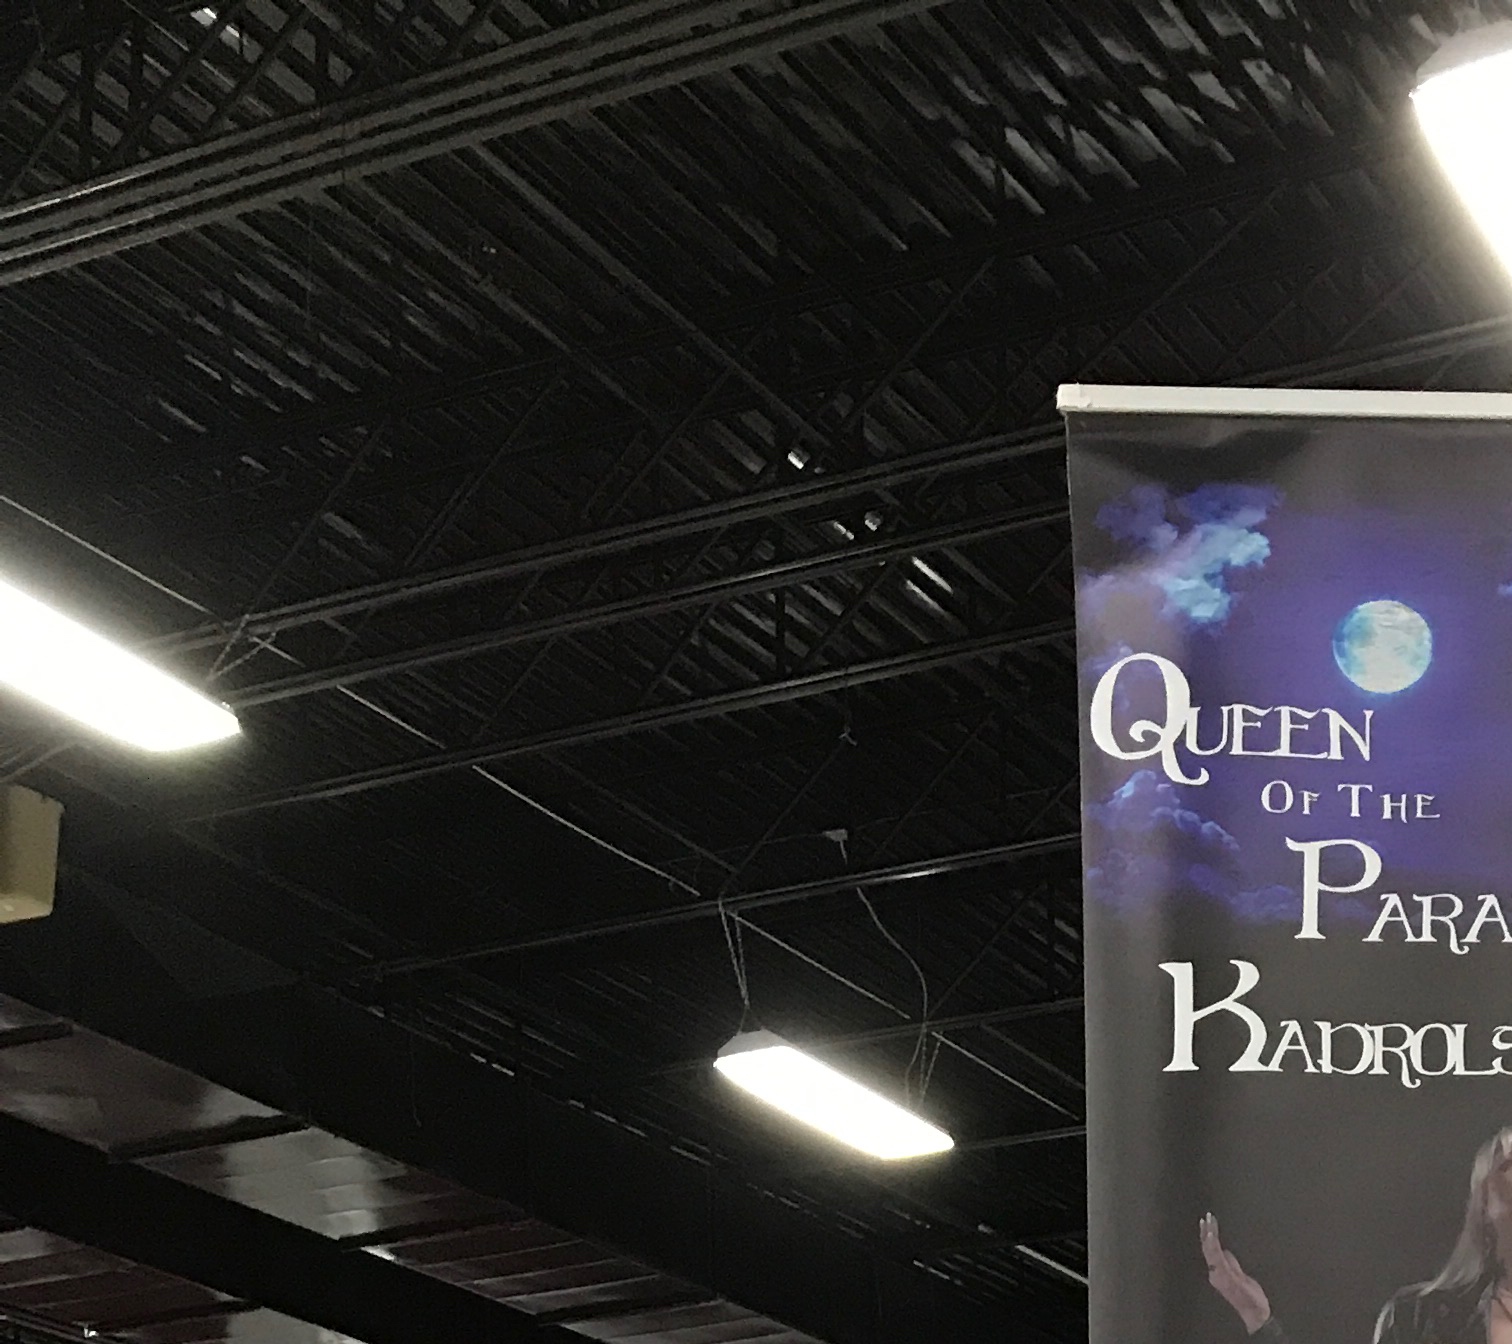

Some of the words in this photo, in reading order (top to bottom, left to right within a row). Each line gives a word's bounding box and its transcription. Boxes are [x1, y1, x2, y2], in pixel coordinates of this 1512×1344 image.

[1090, 653, 1374, 785] QUEEN
[1261, 780, 1321, 815] OF
[1337, 784, 1440, 824] THE
